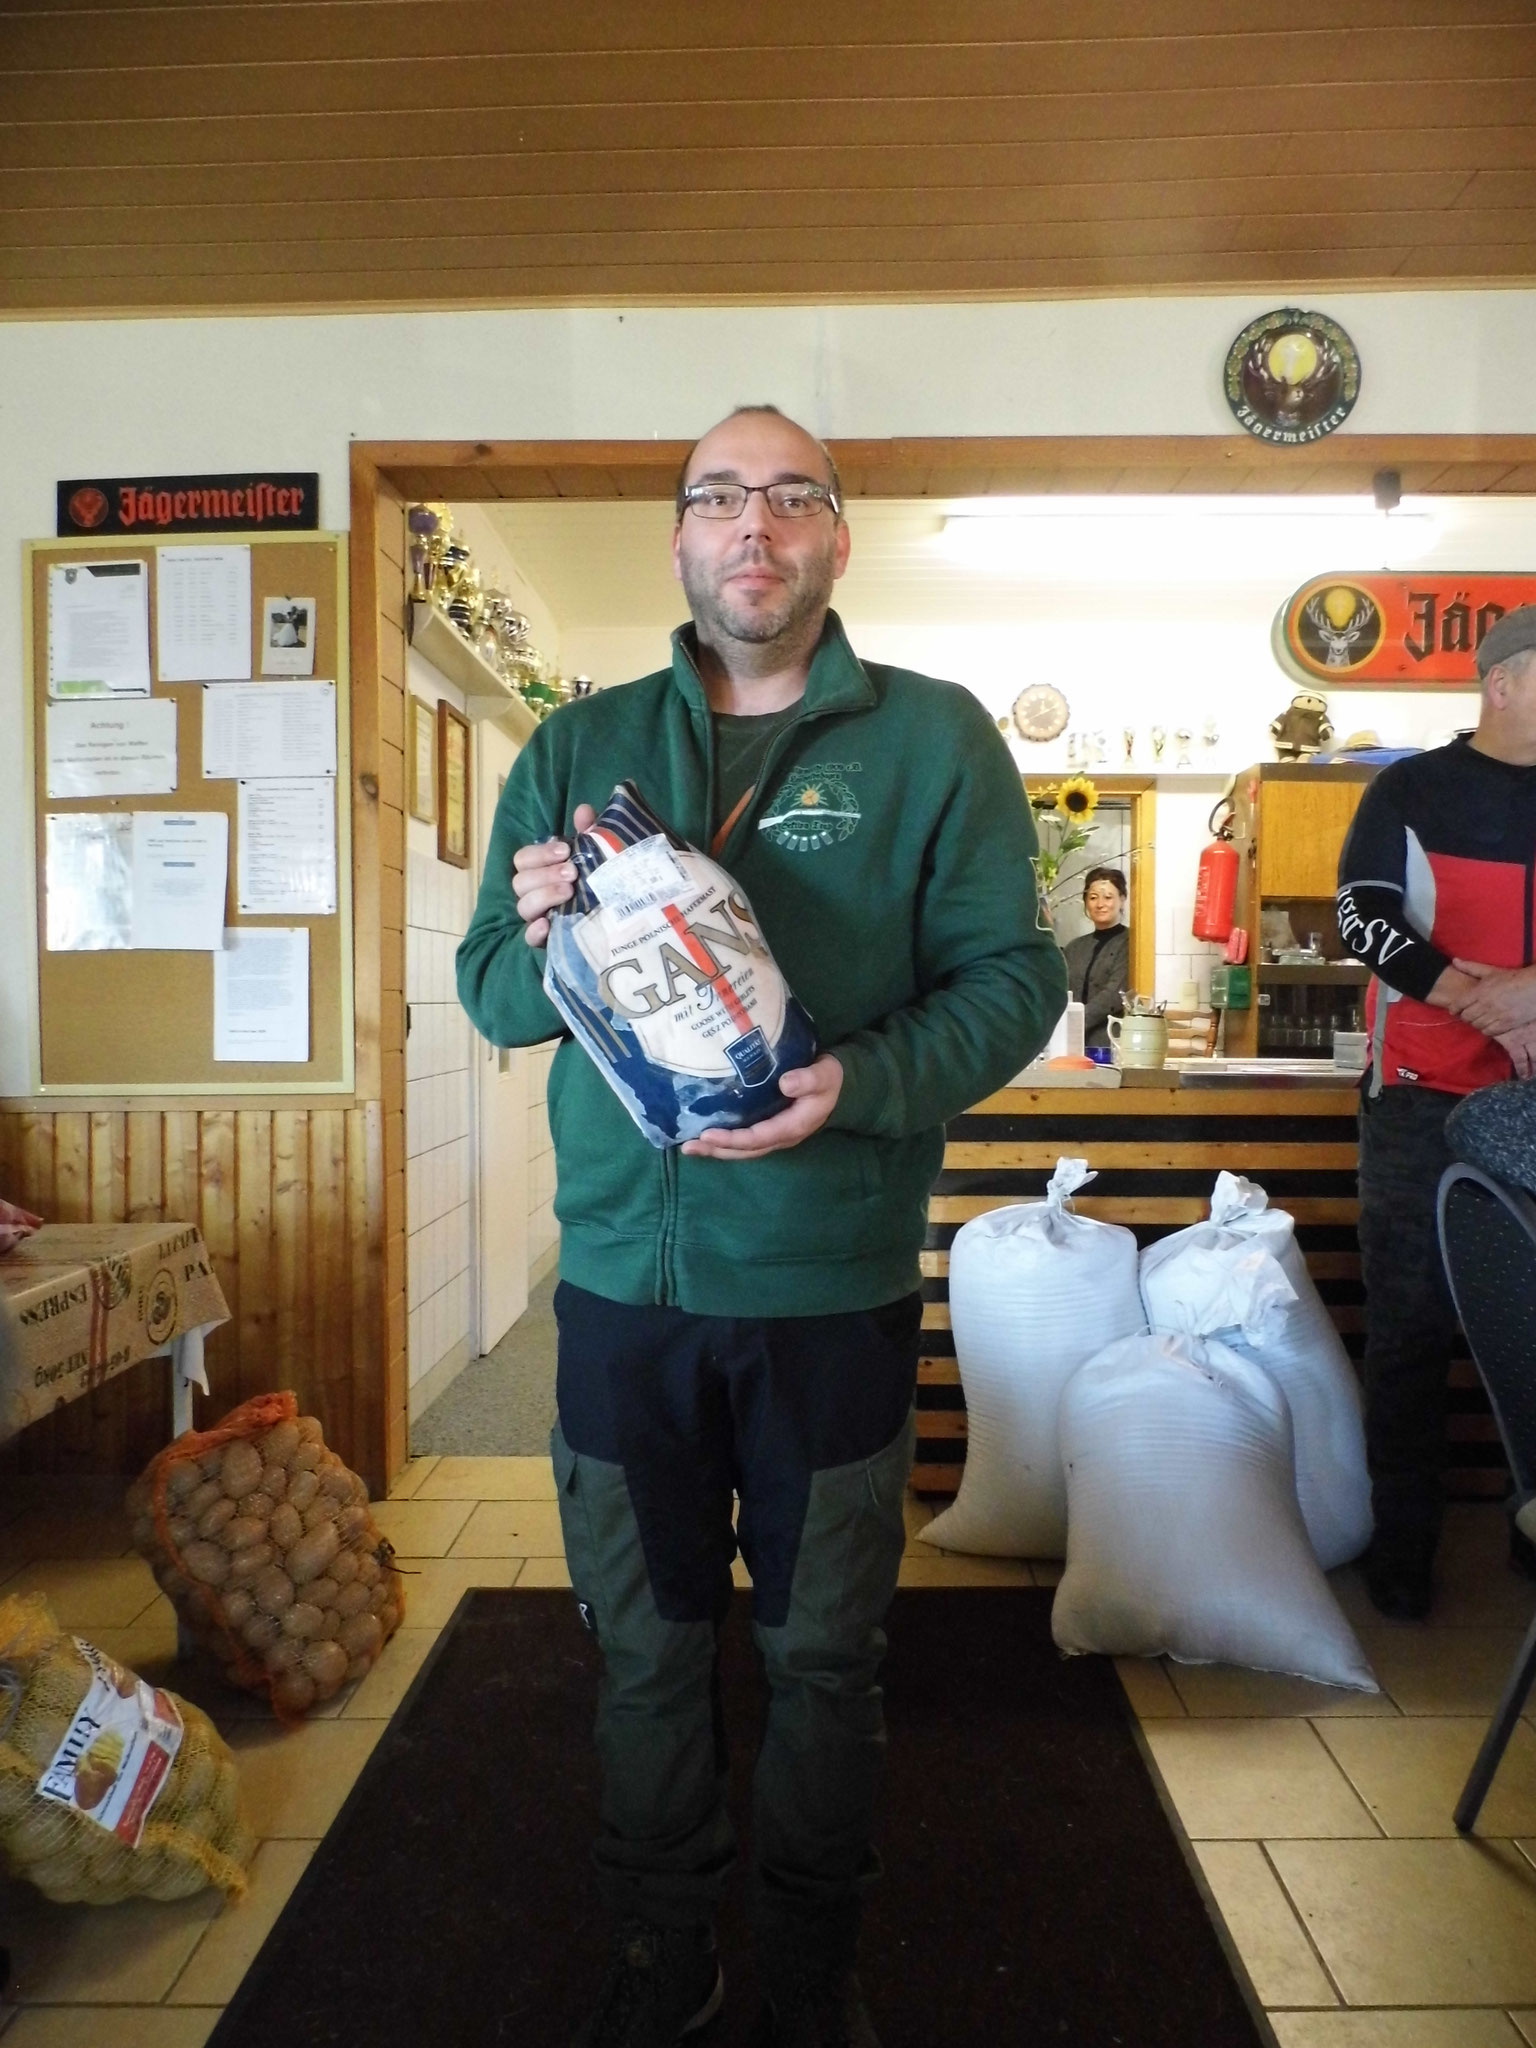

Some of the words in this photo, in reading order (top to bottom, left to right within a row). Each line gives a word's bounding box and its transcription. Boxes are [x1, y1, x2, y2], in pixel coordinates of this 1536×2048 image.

[1404, 591, 1508, 662] Jäg
[597, 888, 769, 1020] GANS
[611, 940, 638, 957] JUNGE
[680, 885, 717, 920] HAFERMAST
[674, 1004, 694, 1023] mit
[691, 1014, 716, 1031] GOOSE
